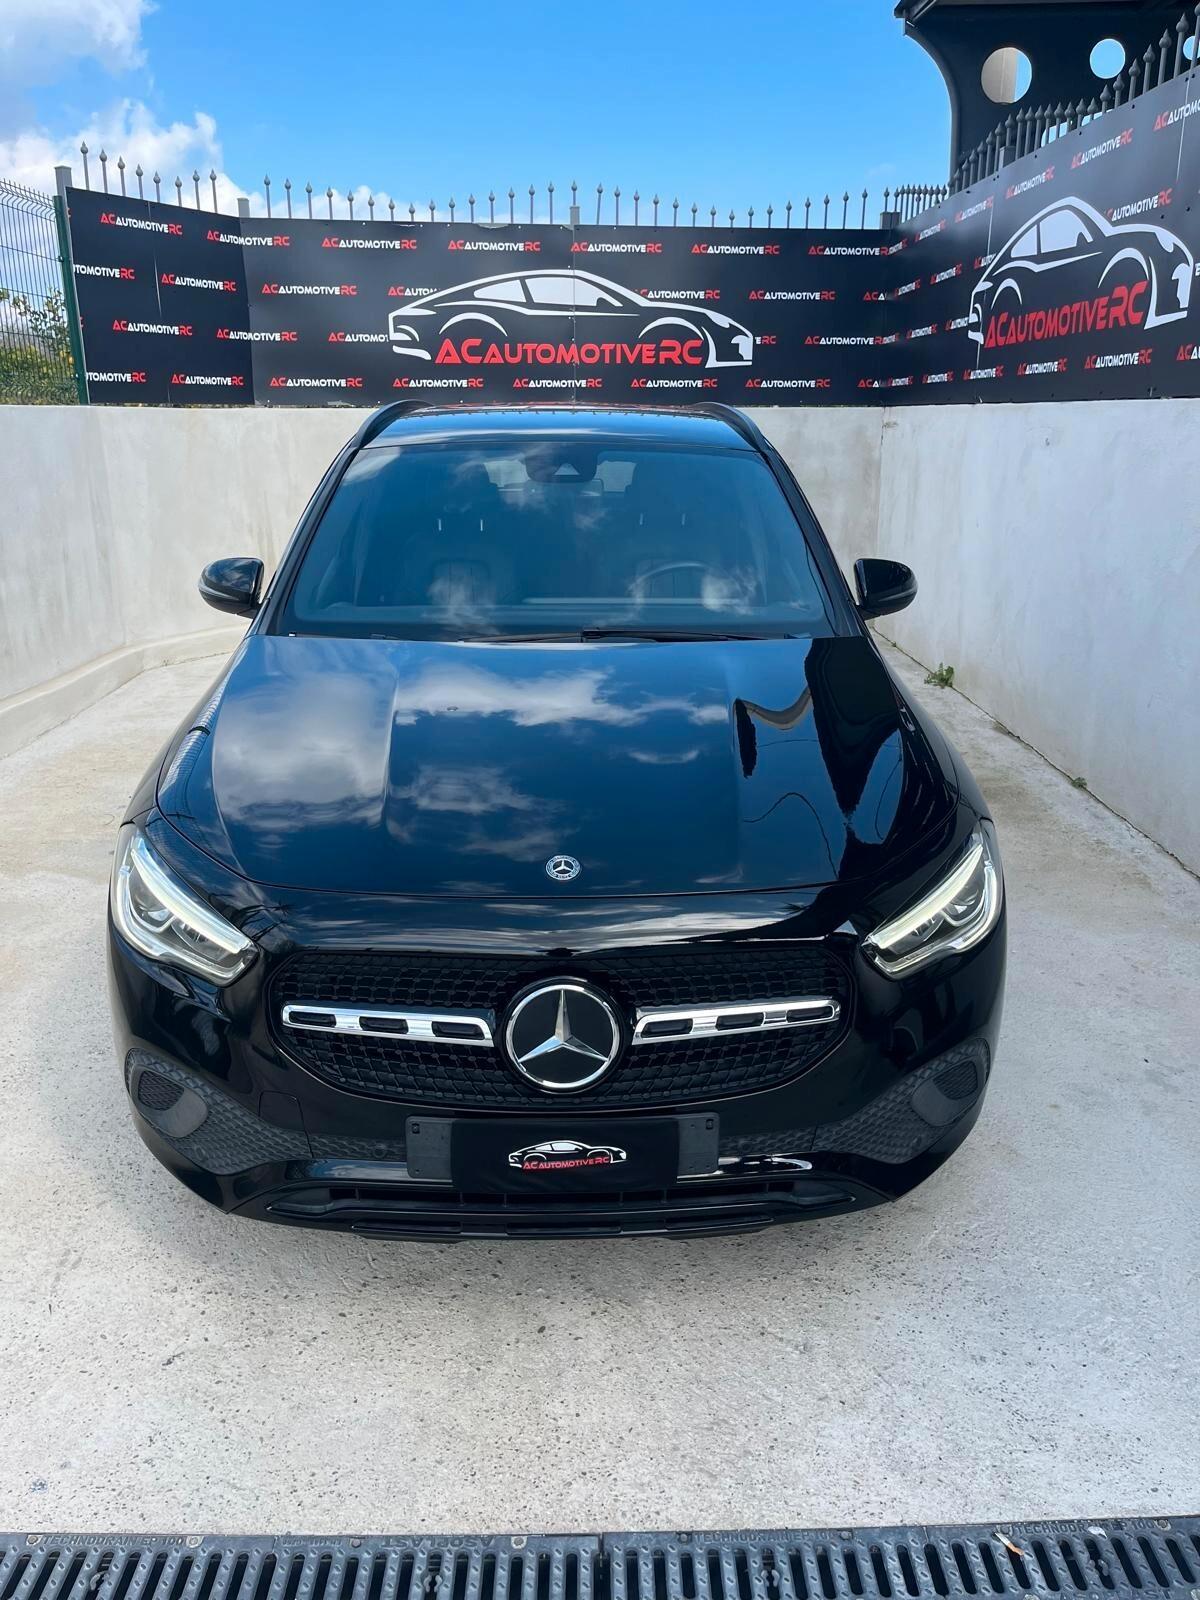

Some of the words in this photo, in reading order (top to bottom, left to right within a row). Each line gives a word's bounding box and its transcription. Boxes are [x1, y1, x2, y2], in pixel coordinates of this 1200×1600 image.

[1104, 187, 1172, 221] CAUTOMOTIVERC
[100, 212, 183, 236] ACAUTOMOTIVERC
[206, 230, 290, 246] ACAUTOMOTIVERC
[321, 237, 417, 250] ACAUTOMOTIVERC
[448, 239, 541, 251] ACAUTOMOTIVERC
[570, 241, 662, 253] ACAUTOMOTIVERC
[691, 244, 780, 255] ACAUTOMOTIVERC
[161, 273, 237, 292] ACAUTOMOTIVERC
[261, 284, 357, 296] ACAUTOMOTIVERC
[634, 288, 720, 299] CAUTOMOTIVERC
[748, 290, 836, 301] ACAUTOMOTIVERC
[984, 280, 1148, 348] ACAUTOMOTIVERC
[112, 319, 193, 336] ACAUTOMOTIVERC
[216, 329, 298, 342] ACAUTOMOTIVERC
[434, 338, 704, 365] ACAUTOMOTIVERC
[1084, 349, 1153, 369] ACAUTOMOTIVERC
[171, 374, 244, 386] ACAUTOMOTIVERC
[270, 377, 363, 388] ACAUTOMOTIVERC
[393, 378, 484, 388] ACAUTOMOTIVERC
[512, 378, 602, 388] ACAUTOMOTIVERC
[631, 378, 718, 388] ACAUTOMOTIVERC
[745, 378, 831, 388] ACAUTOMOTIVERC
